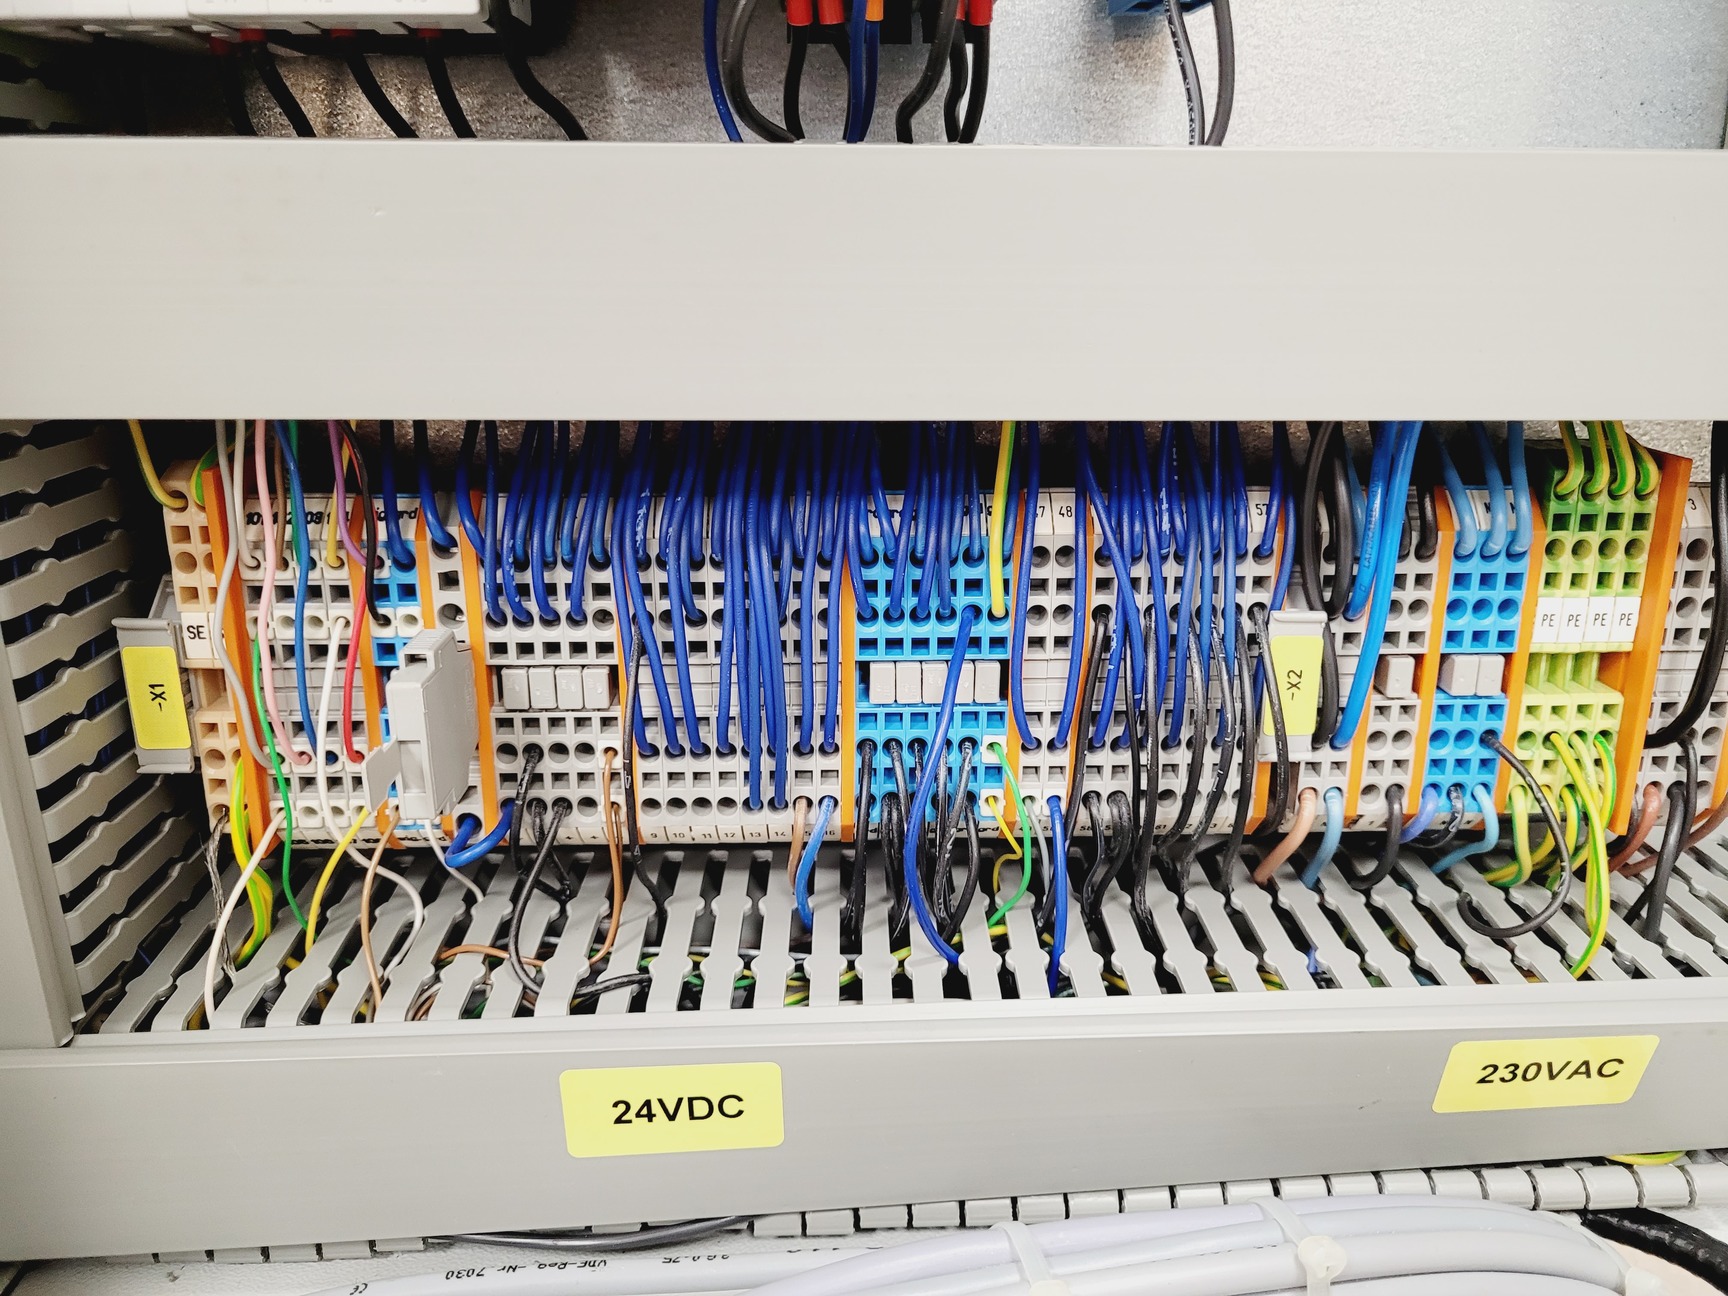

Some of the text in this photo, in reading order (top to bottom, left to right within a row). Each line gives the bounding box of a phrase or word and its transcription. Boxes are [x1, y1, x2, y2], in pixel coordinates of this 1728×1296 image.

[1058, 505, 1073, 518] 48
[1541, 613, 1556, 628] PE
[1567, 613, 1582, 628] PE
[1593, 612, 1608, 627] PE
[1618, 612, 1634, 627] PE
[186, 625, 207, 640] SE
[1286, 669, 1303, 701] -X2
[148, 683, 168, 712] -X1
[1475, 1058, 1625, 1085] 230VAC
[611, 1094, 745, 1125] 24VDC
[445, 1266, 487, 1280] 7030
